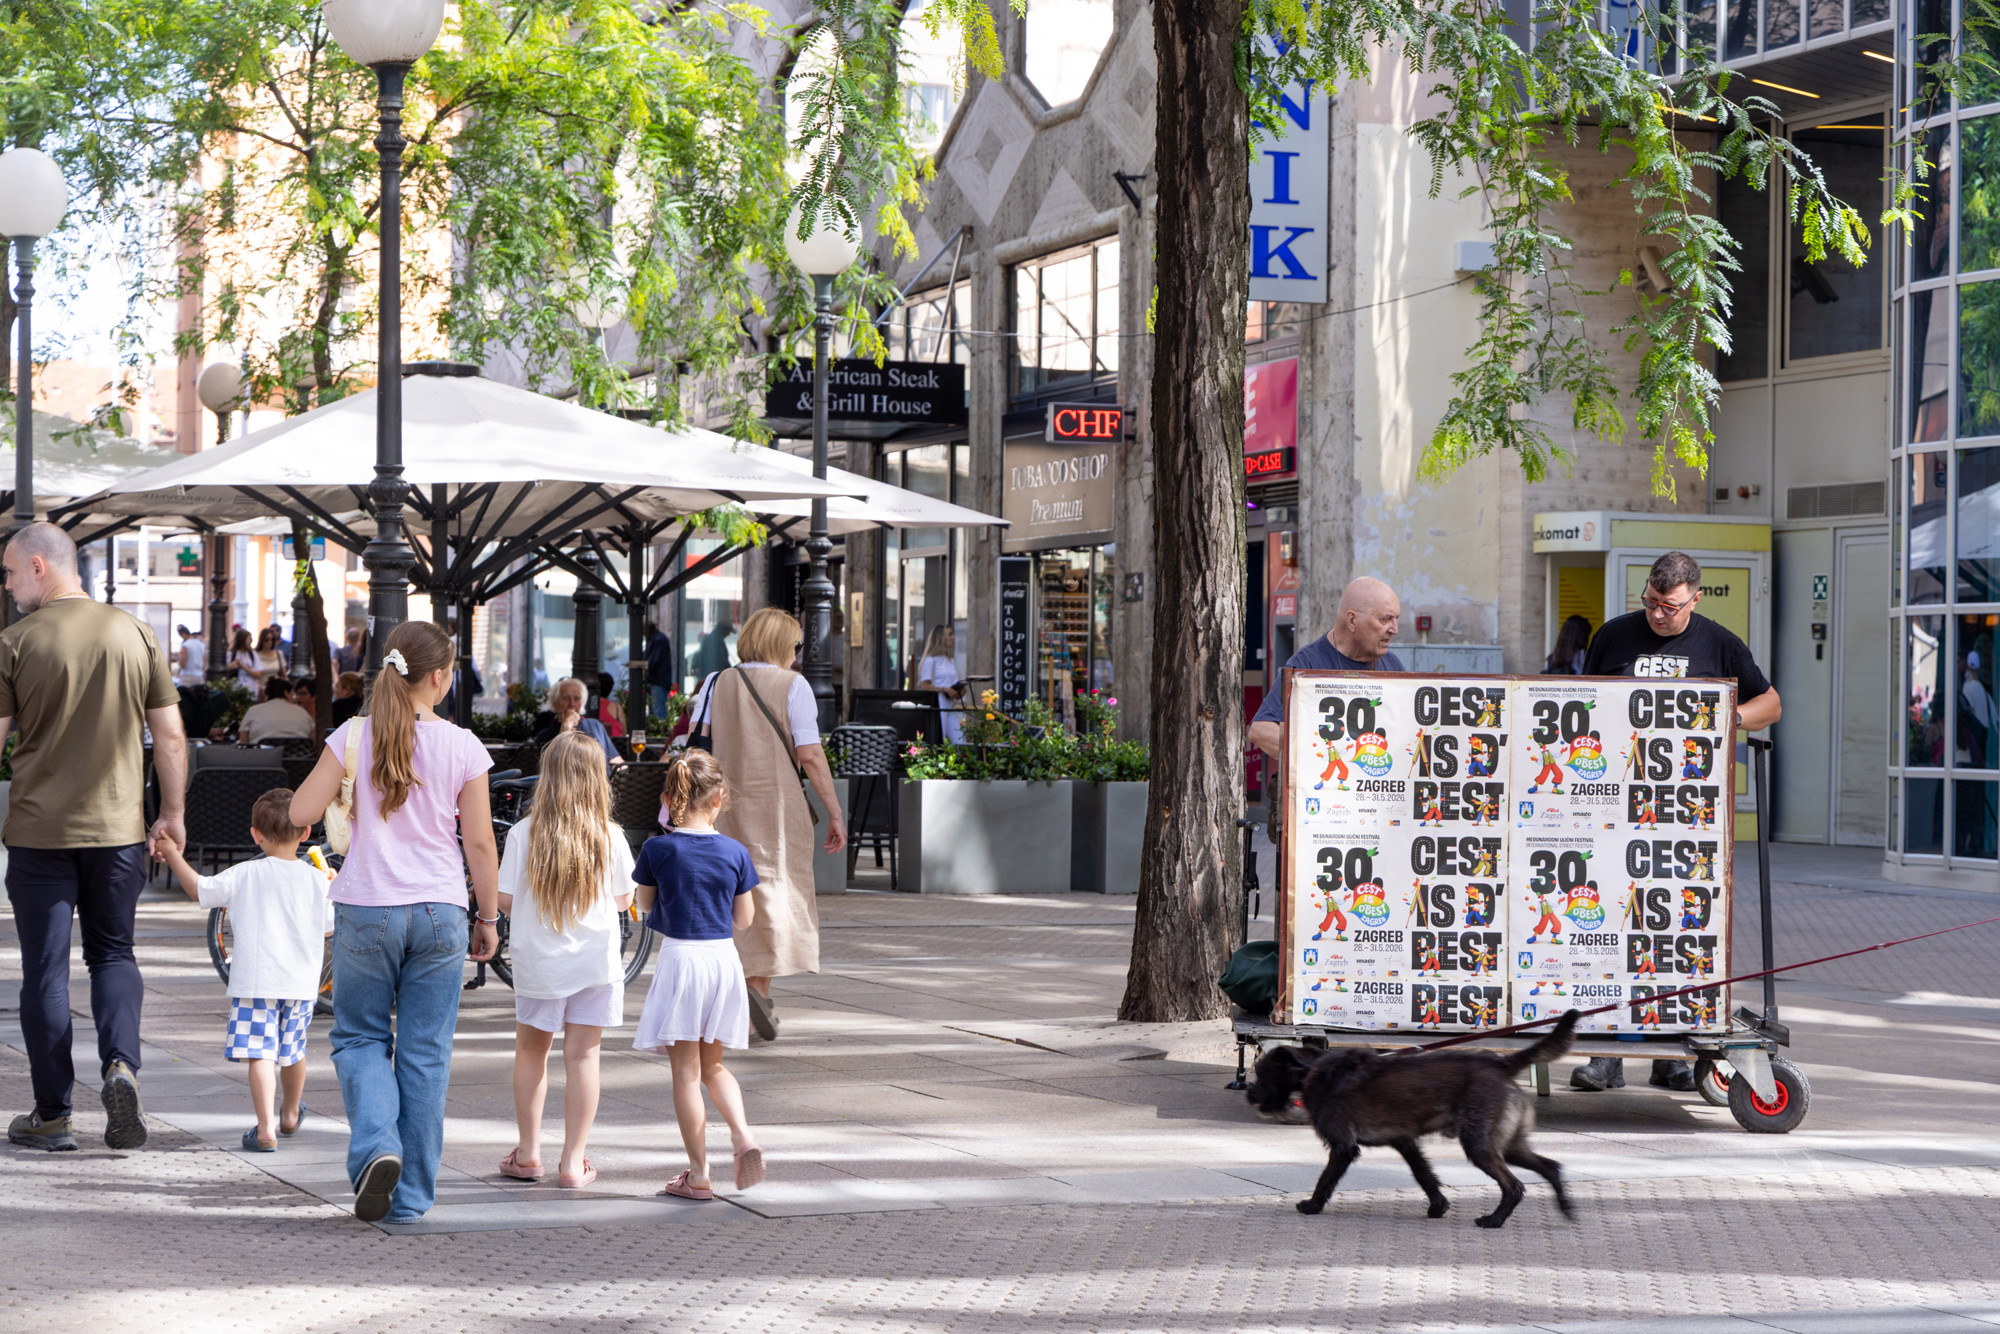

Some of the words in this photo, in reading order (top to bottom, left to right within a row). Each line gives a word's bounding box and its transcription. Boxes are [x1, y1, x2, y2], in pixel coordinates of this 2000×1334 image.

[888, 368, 940, 388] Steak
[797, 391, 814, 411] &
[872, 395, 932, 415] House
[1054, 409, 1121, 438] CHF
[1010, 459, 1068, 491] TOBACCO
[1070, 453, 1109, 483] SHOP
[1030, 494, 1083, 522] Premium
[1004, 605, 1014, 692] TOBACCO
[1634, 656, 1689, 677] CEST
[1414, 686, 1506, 727] CEST
[1629, 689, 1720, 729] CEST
[1360, 734, 1386, 745] CEST
[1574, 738, 1599, 748] CEST
[1366, 745, 1377, 754] IS
[1581, 748, 1591, 757] IS
[1418, 735, 1458, 778] IS
[1633, 737, 1673, 781] IS
[1363, 765, 1390, 776] ZAGREB
[1577, 769, 1603, 779] ZAGREB
[1356, 780, 1406, 793] ZAGREB
[1571, 783, 1620, 796] ZAGREB
[1413, 781, 1505, 821] BEST
[1628, 784, 1720, 824] BEST
[1326, 807, 1351, 817] Zagreb
[1540, 811, 1565, 820] Zagreb
[1411, 836, 1502, 876] CEST
[1626, 839, 1717, 879] CEST
[1357, 885, 1382, 895] CEST
[1571, 888, 1597, 898] CEST
[1364, 895, 1374, 904] IS
[1417, 884, 1455, 928] IS
[1578, 898, 1588, 907] IS
[1632, 887, 1670, 931] IS
[1361, 916, 1387, 927] ZAGREB
[1575, 919, 1601, 930] ZAGREB
[1354, 930, 1404, 943] ZAGREB
[1569, 933, 1619, 946] ZAGREB
[1411, 931, 1502, 971] BEST
[1627, 934, 1717, 974] BEST
[1324, 958, 1349, 967] Zagreb
[1539, 961, 1564, 970] Zagreb
[1354, 982, 1404, 995] ZAGREB
[1572, 985, 1622, 997] ZAGREB
[1411, 984, 1502, 1024] BEST
[1323, 1008, 1348, 1018] Zagreb
